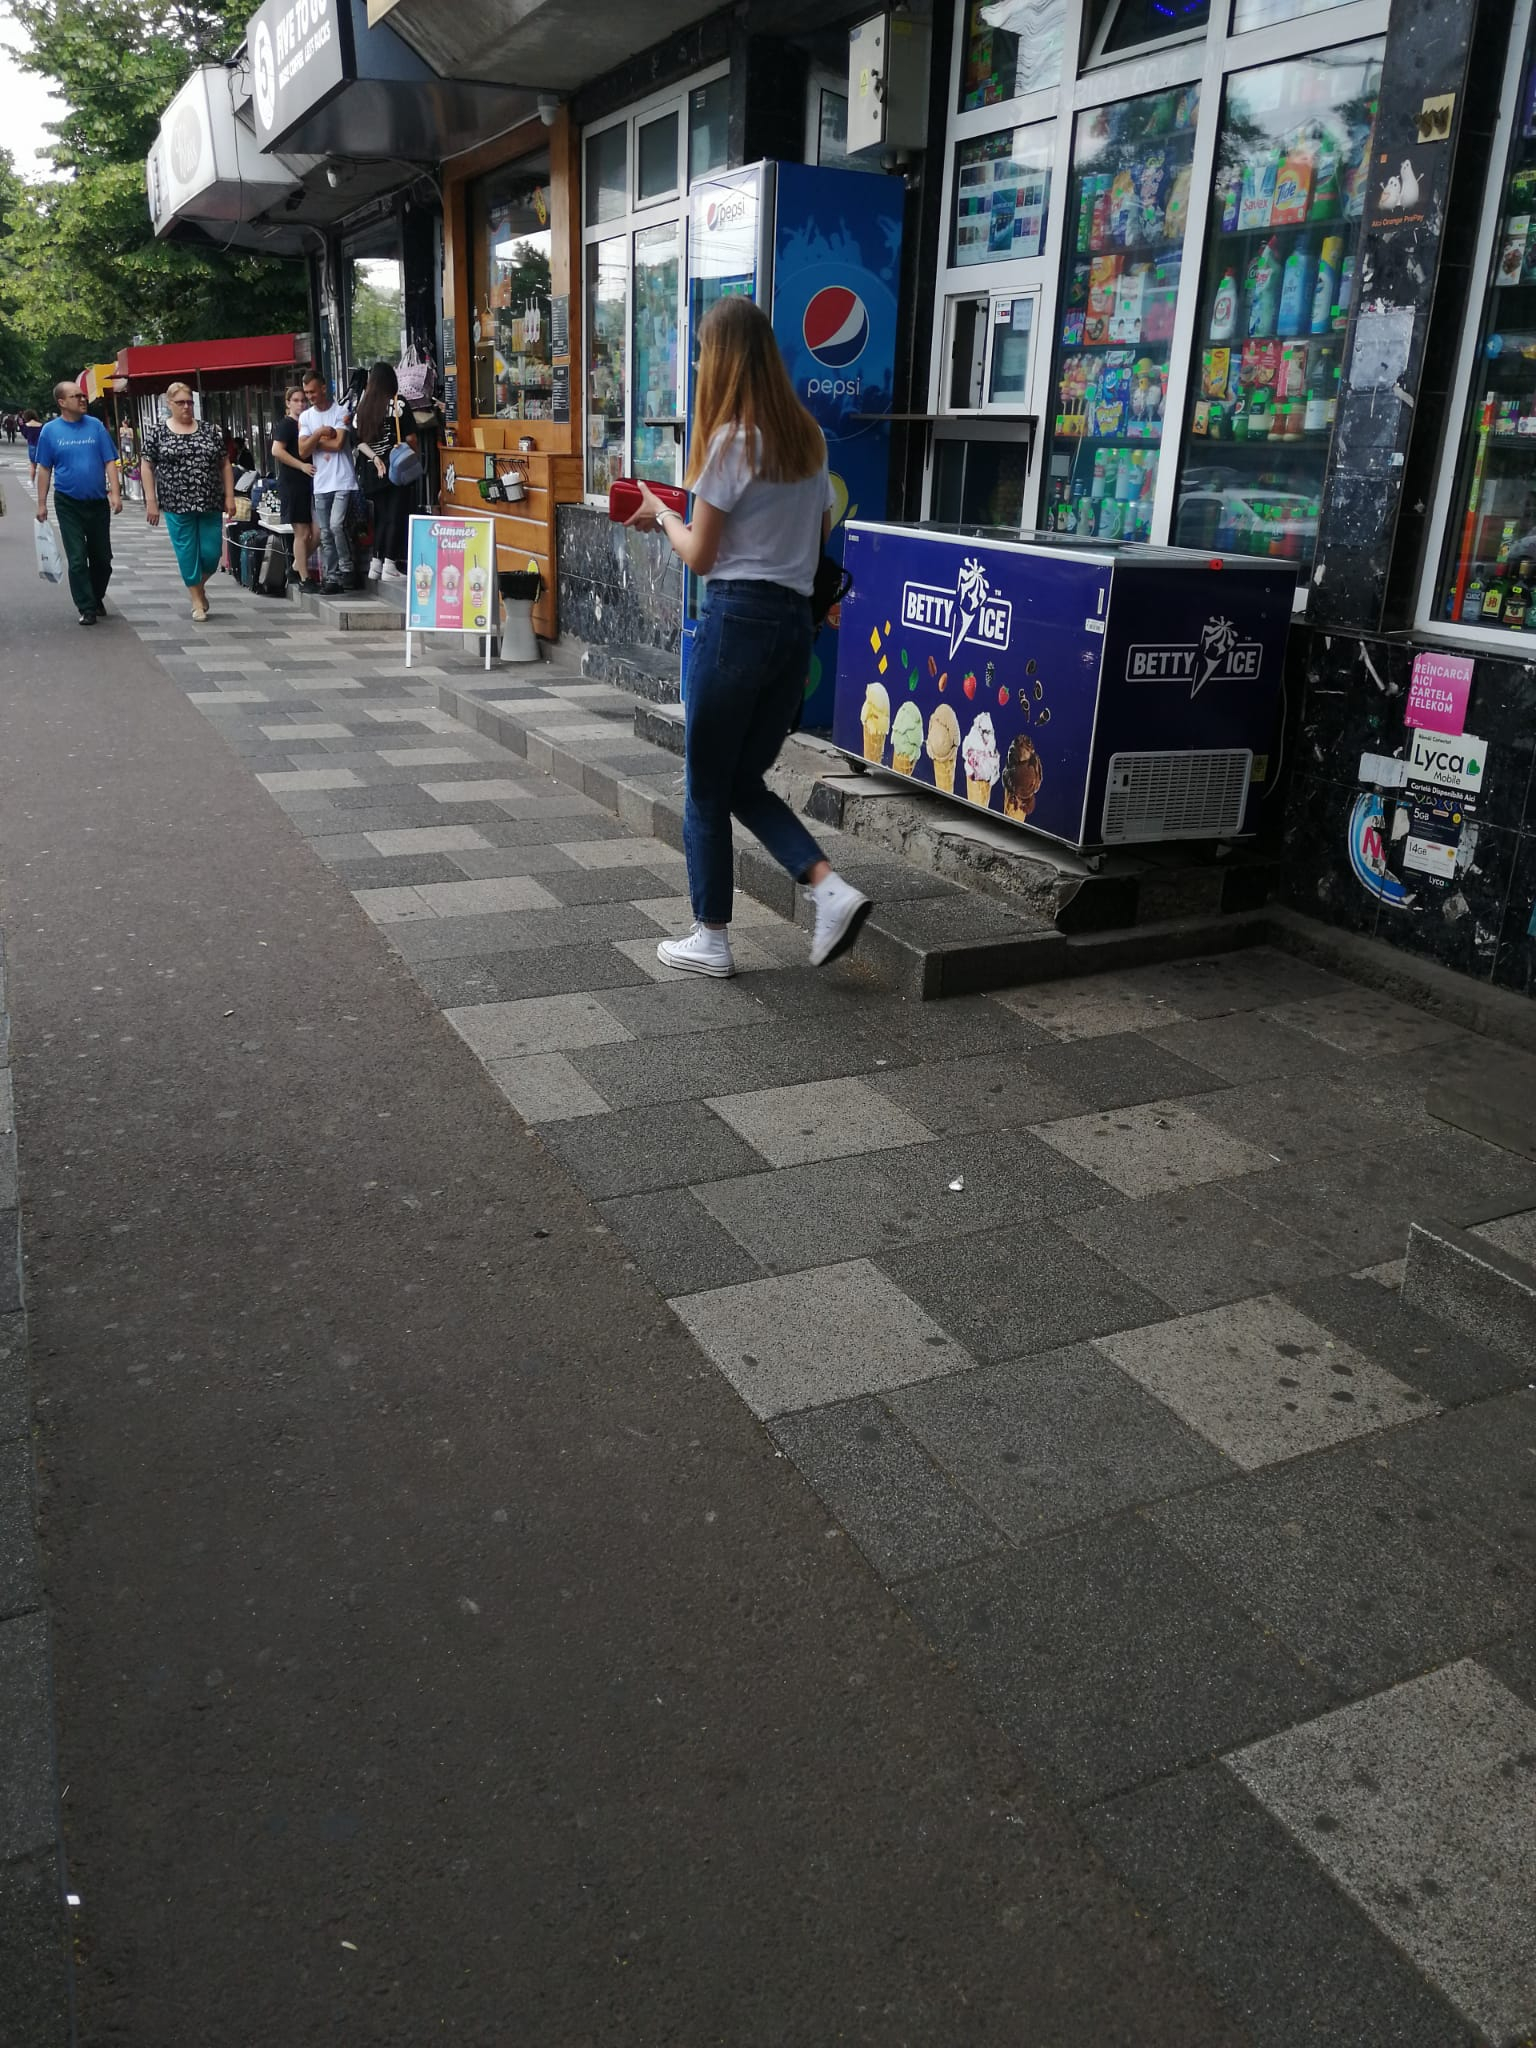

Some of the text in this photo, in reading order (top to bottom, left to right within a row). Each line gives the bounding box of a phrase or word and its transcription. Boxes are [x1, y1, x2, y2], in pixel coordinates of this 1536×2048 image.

[1276, 180, 1297, 205] Tide
[719, 197, 746, 223] pepsi
[807, 377, 861, 399] pepsi
[431, 522, 476, 537] Summer
[907, 591, 954, 629] BETTY
[978, 606, 1007, 642] ICE
[1133, 652, 1196, 675] BETTY
[1226, 651, 1257, 674] ICE
[1412, 675, 1433, 687] AICI
[1410, 685, 1453, 703] CARTELA
[1409, 696, 1453, 715] TELEKOM
[1414, 743, 1464, 774] Lyca
[1433, 771, 1461, 785] Mobile
[1413, 807, 1430, 821] 5GB
[1409, 841, 1428, 856] 14GB
[1428, 875, 1445, 888] Lyca
